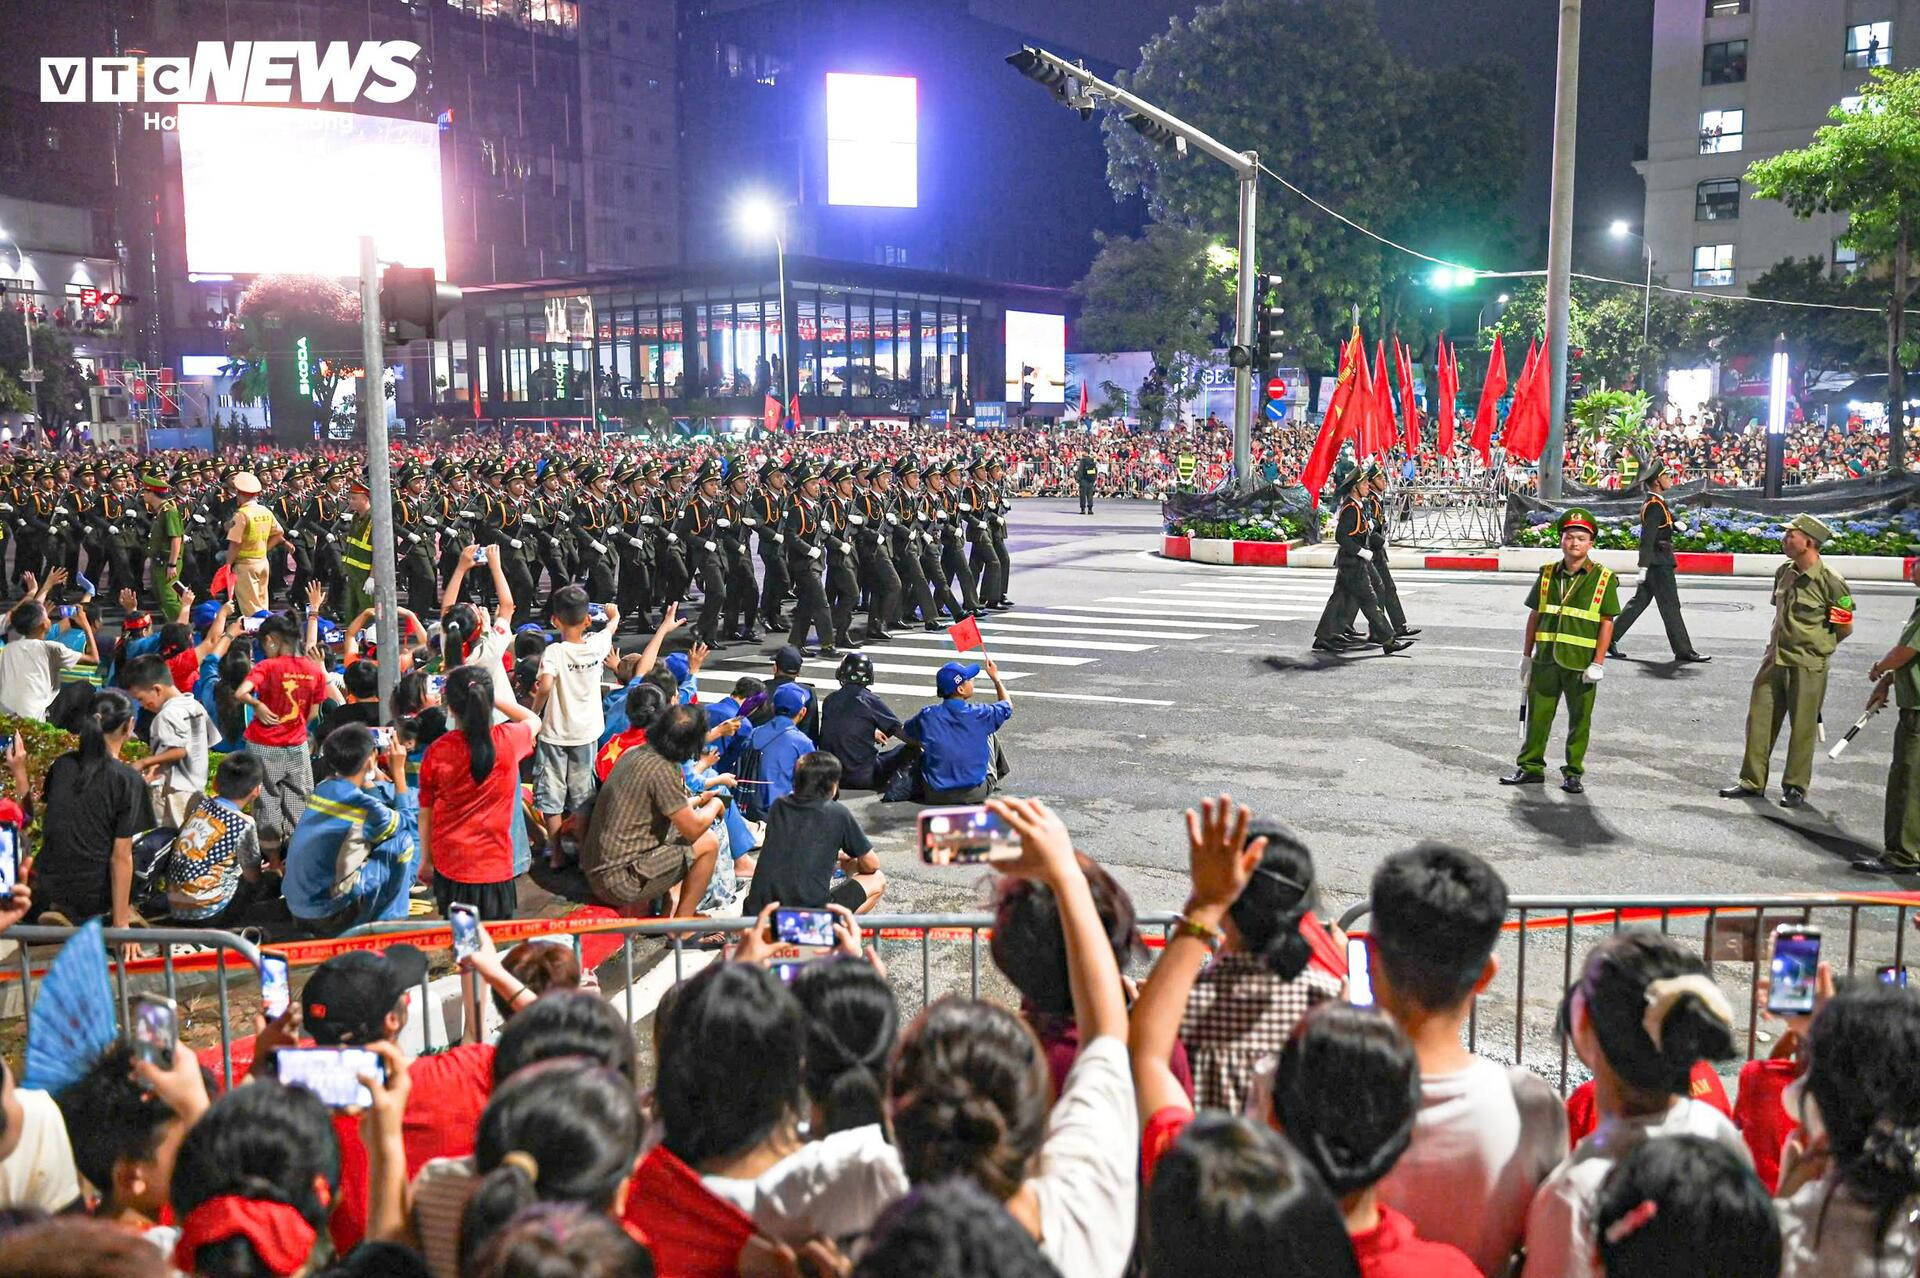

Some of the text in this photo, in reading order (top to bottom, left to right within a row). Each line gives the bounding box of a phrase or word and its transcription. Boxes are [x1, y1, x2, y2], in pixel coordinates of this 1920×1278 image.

[297, 336, 310, 395] SKODA
[1593, 571, 1609, 604] CAHN
[549, 919, 567, 930] DO
[569, 918, 593, 928] NOT
